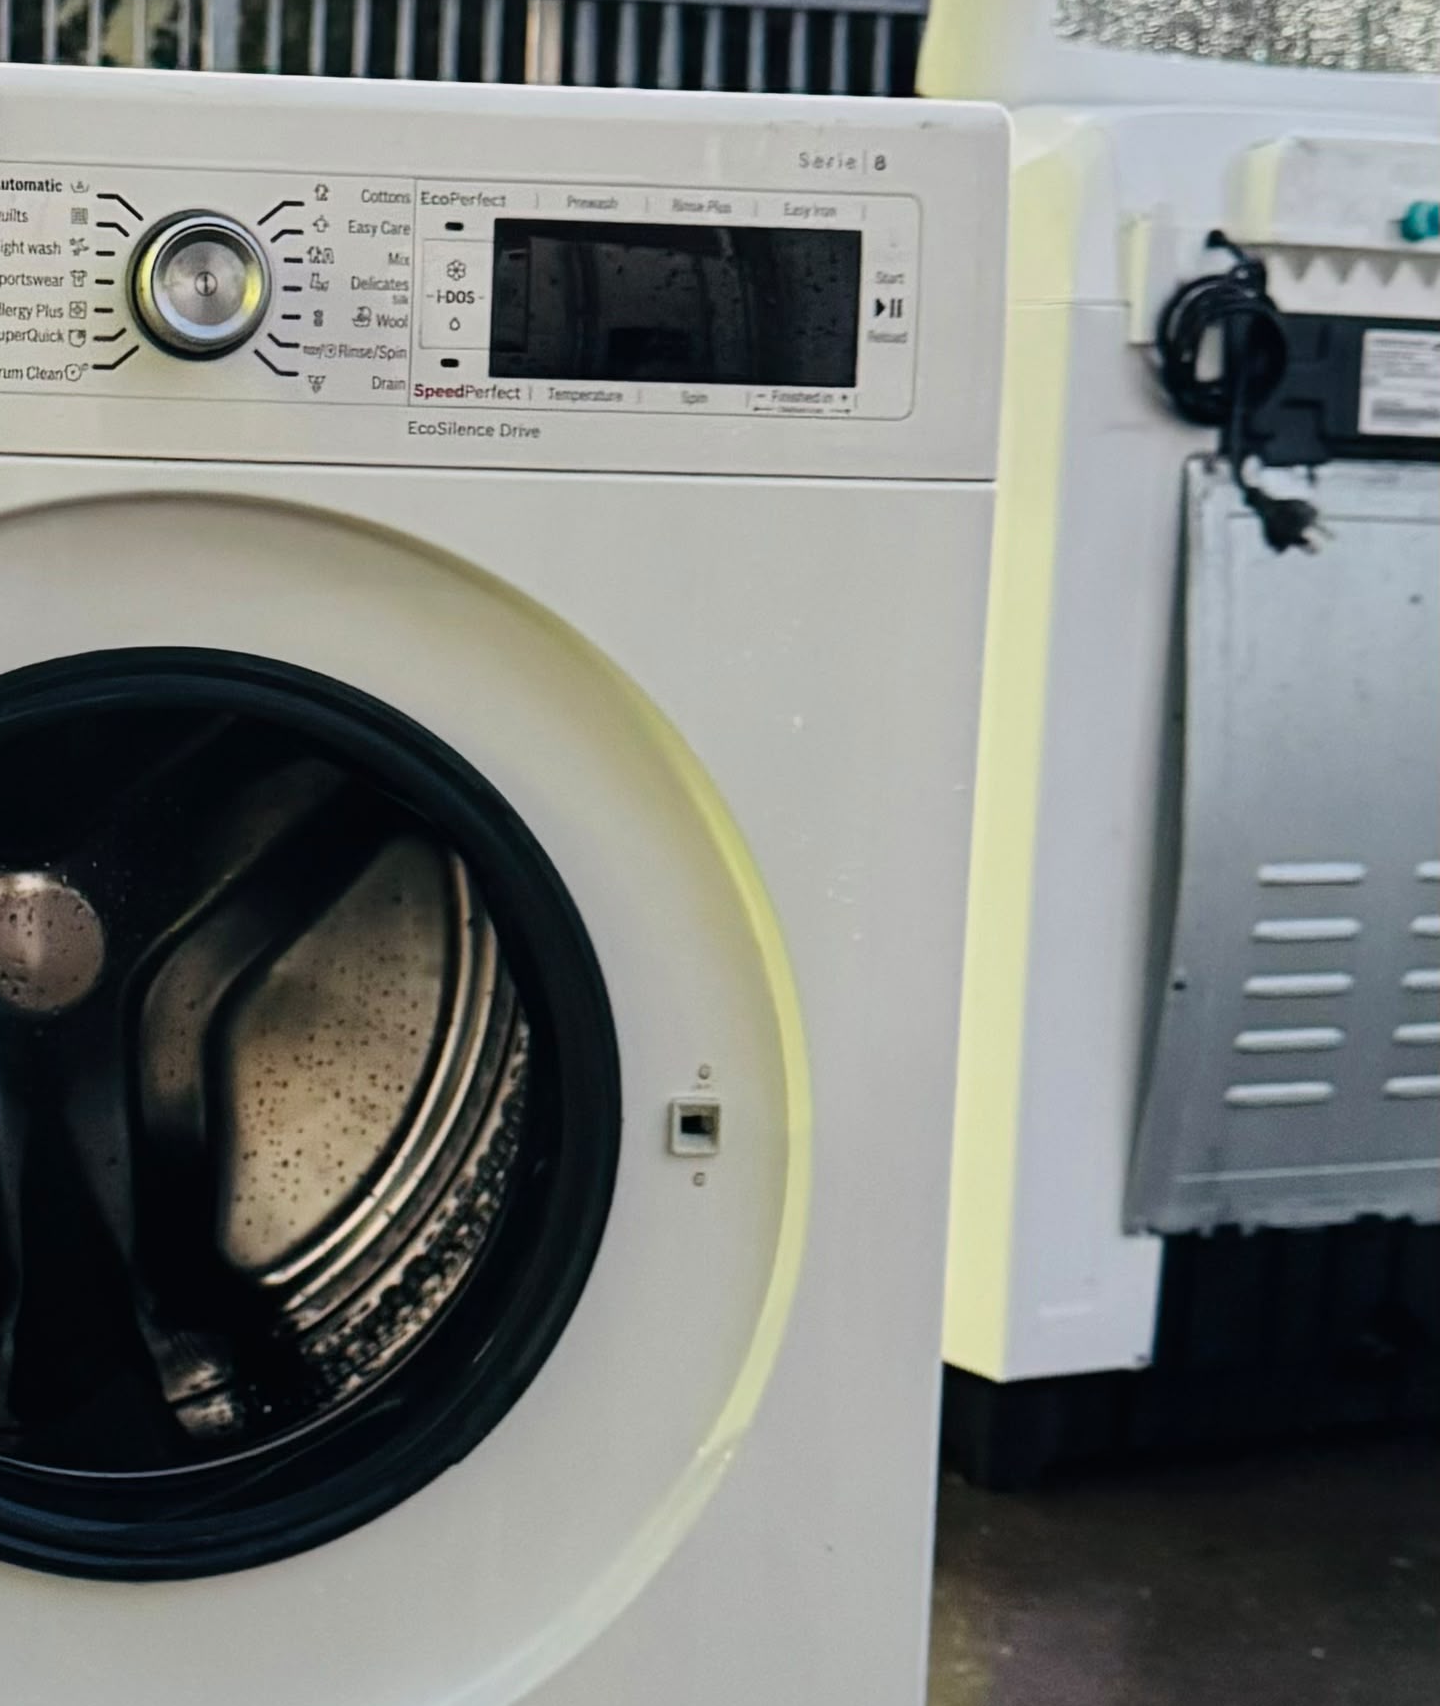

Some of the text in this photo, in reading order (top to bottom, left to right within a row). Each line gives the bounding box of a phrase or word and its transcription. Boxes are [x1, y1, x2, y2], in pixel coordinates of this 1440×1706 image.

[798, 150, 888, 172] Serie 8
[361, 189, 411, 204] Cottons
[420, 191, 506, 208] EcoPerfect
[348, 219, 411, 237] Easy Care
[27, 240, 61, 256] wash
[351, 275, 409, 291] Delicates
[36, 304, 64, 319] Plus
[376, 313, 408, 329] Wool
[26, 366, 63, 382] Clean
[372, 376, 405, 390] Drain
[414, 382, 521, 401] SpeedPerfect
[407, 420, 541, 440] EcoSilence Drive
